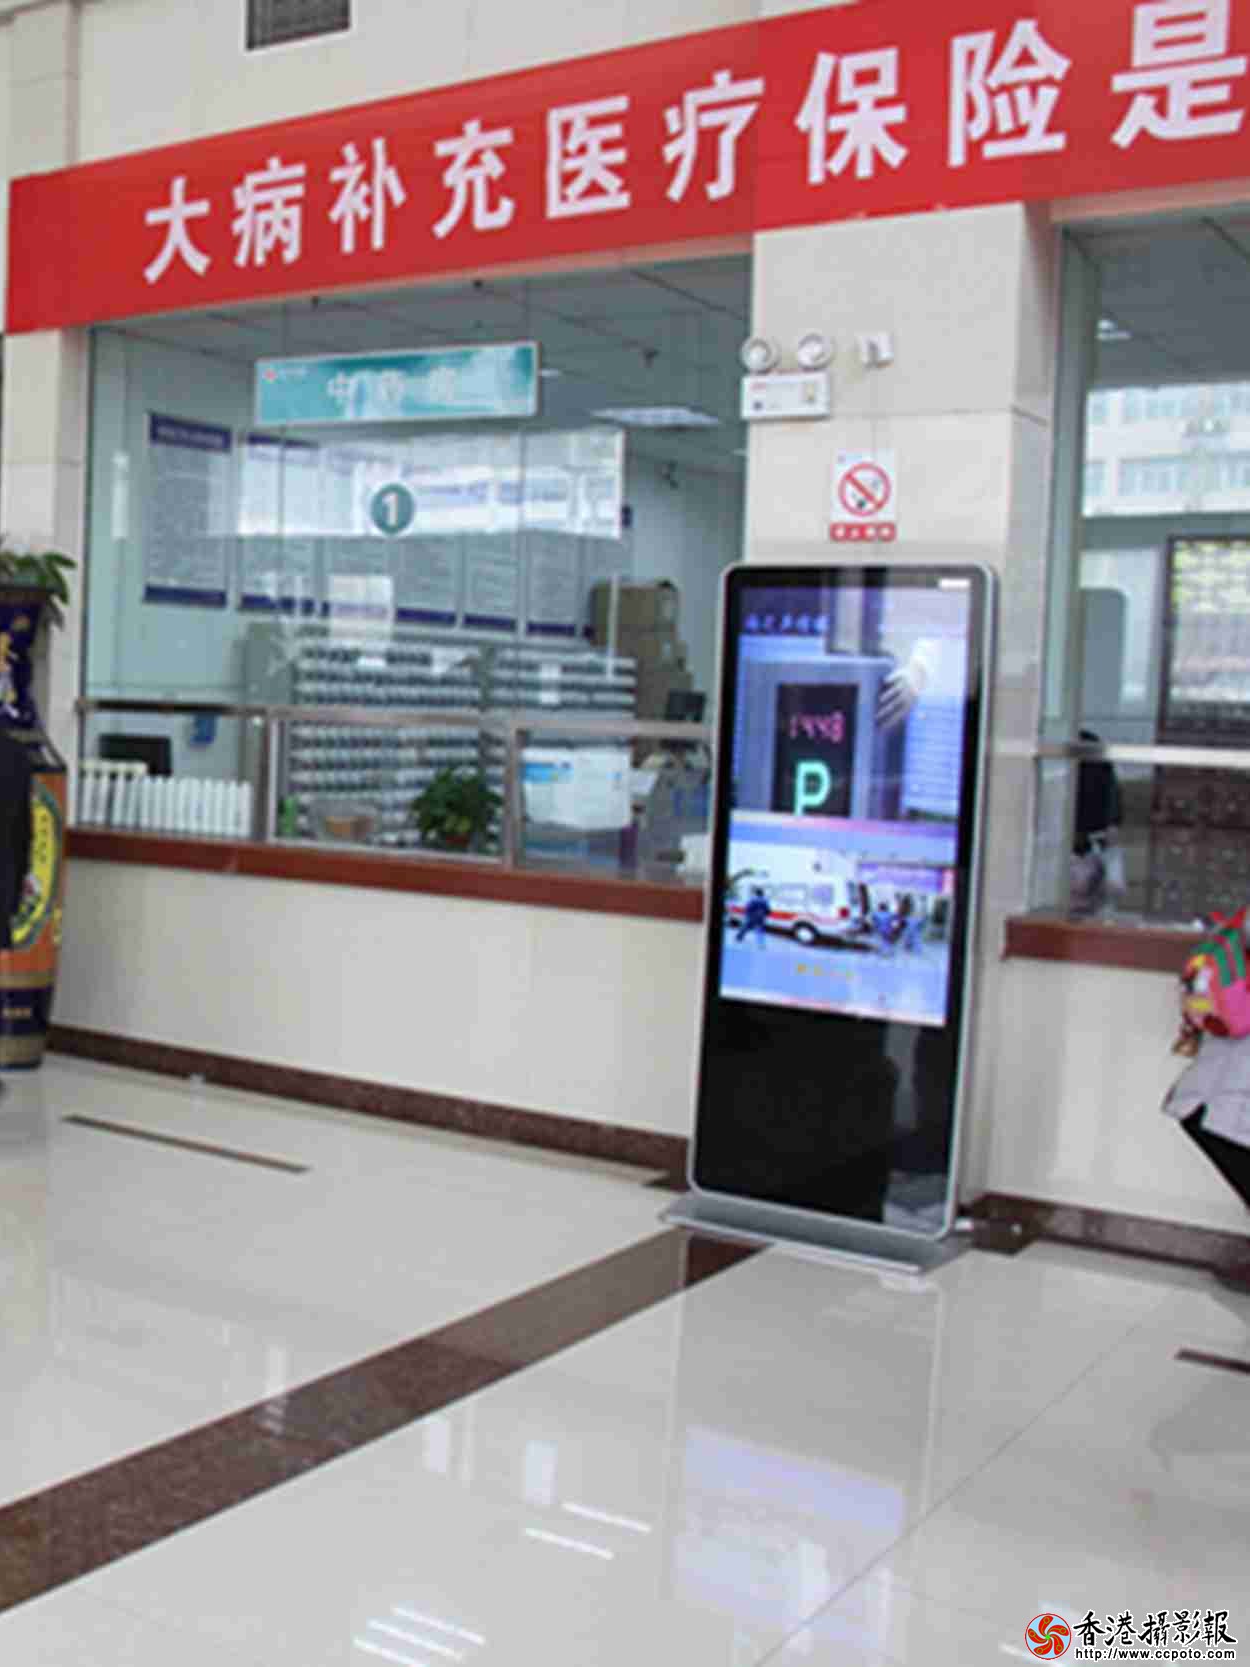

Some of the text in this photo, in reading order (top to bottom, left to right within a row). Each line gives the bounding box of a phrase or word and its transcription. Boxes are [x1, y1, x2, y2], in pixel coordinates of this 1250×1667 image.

[144, 0, 1250, 283] 大病补充医疗保险是
[795, 760, 830, 815] P
